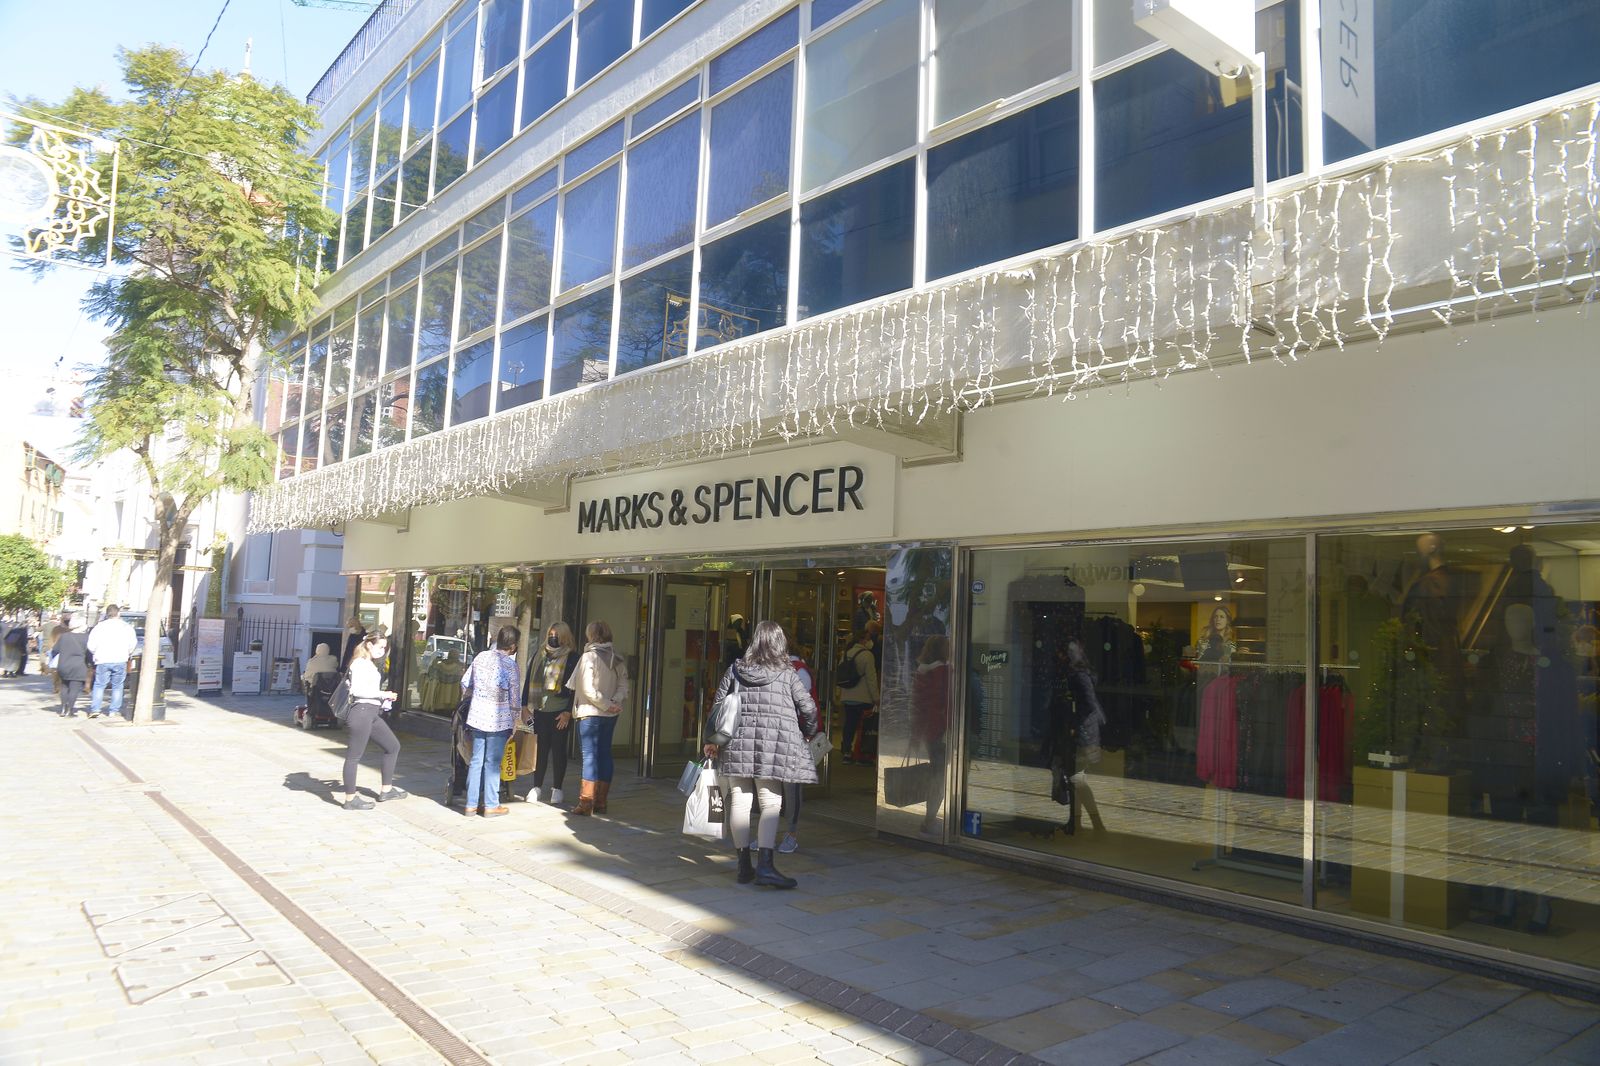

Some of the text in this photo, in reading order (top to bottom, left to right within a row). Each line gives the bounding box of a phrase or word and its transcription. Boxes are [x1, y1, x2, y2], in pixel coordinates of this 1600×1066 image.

[577, 465, 865, 534] MARKS & SPENCER
